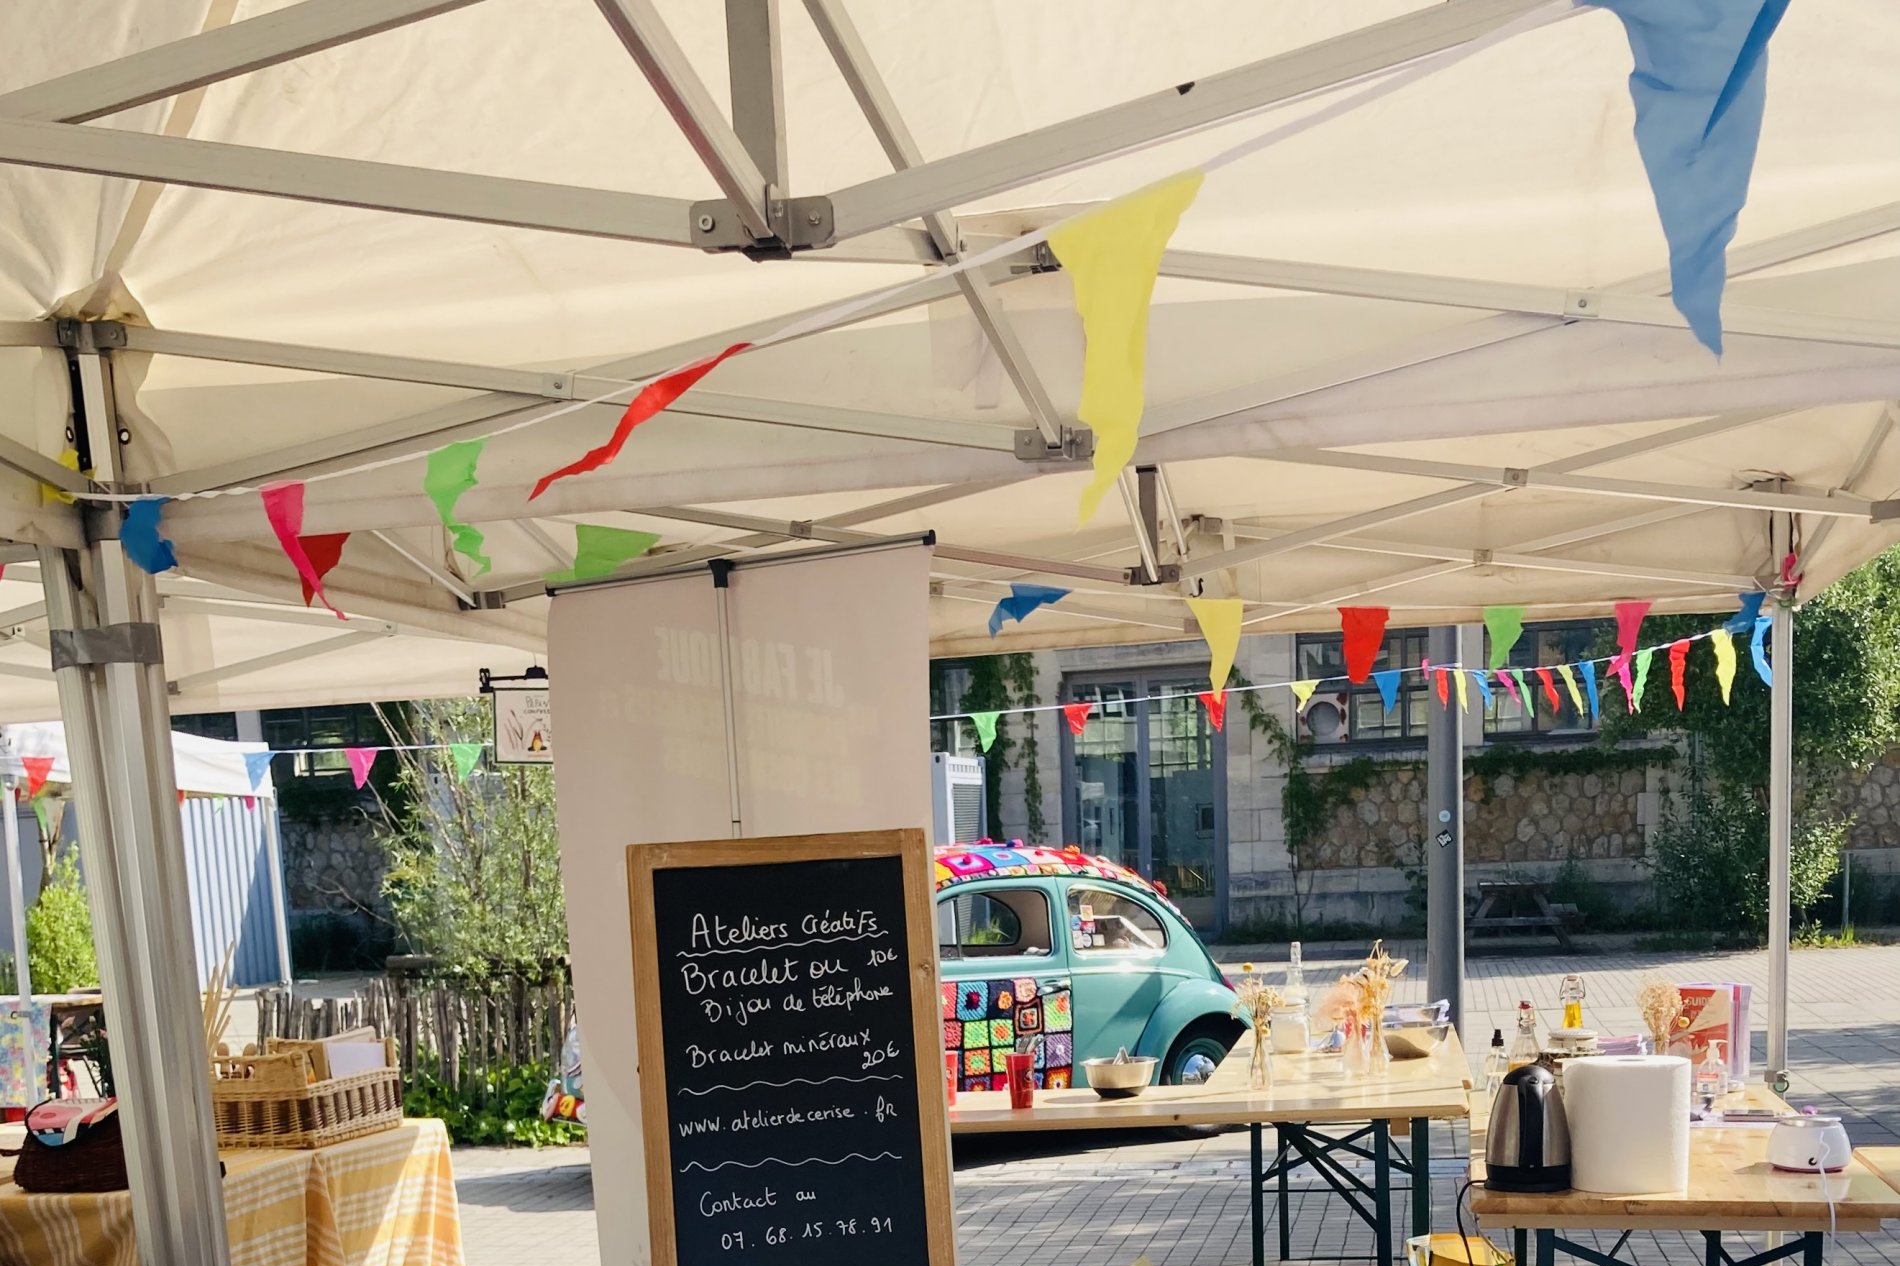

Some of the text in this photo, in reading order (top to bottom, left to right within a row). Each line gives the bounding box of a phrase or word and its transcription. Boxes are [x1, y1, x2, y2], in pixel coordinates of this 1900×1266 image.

[691, 912, 788, 949] Ateliers
[680, 948, 898, 995] Bracelet ou 10€
[700, 976, 894, 1026] Bijou de téléphone
[685, 1028, 871, 1069] Bracelet minéraux
[861, 1040, 900, 1070] 20€
[699, 1186, 817, 1217] Contact au
